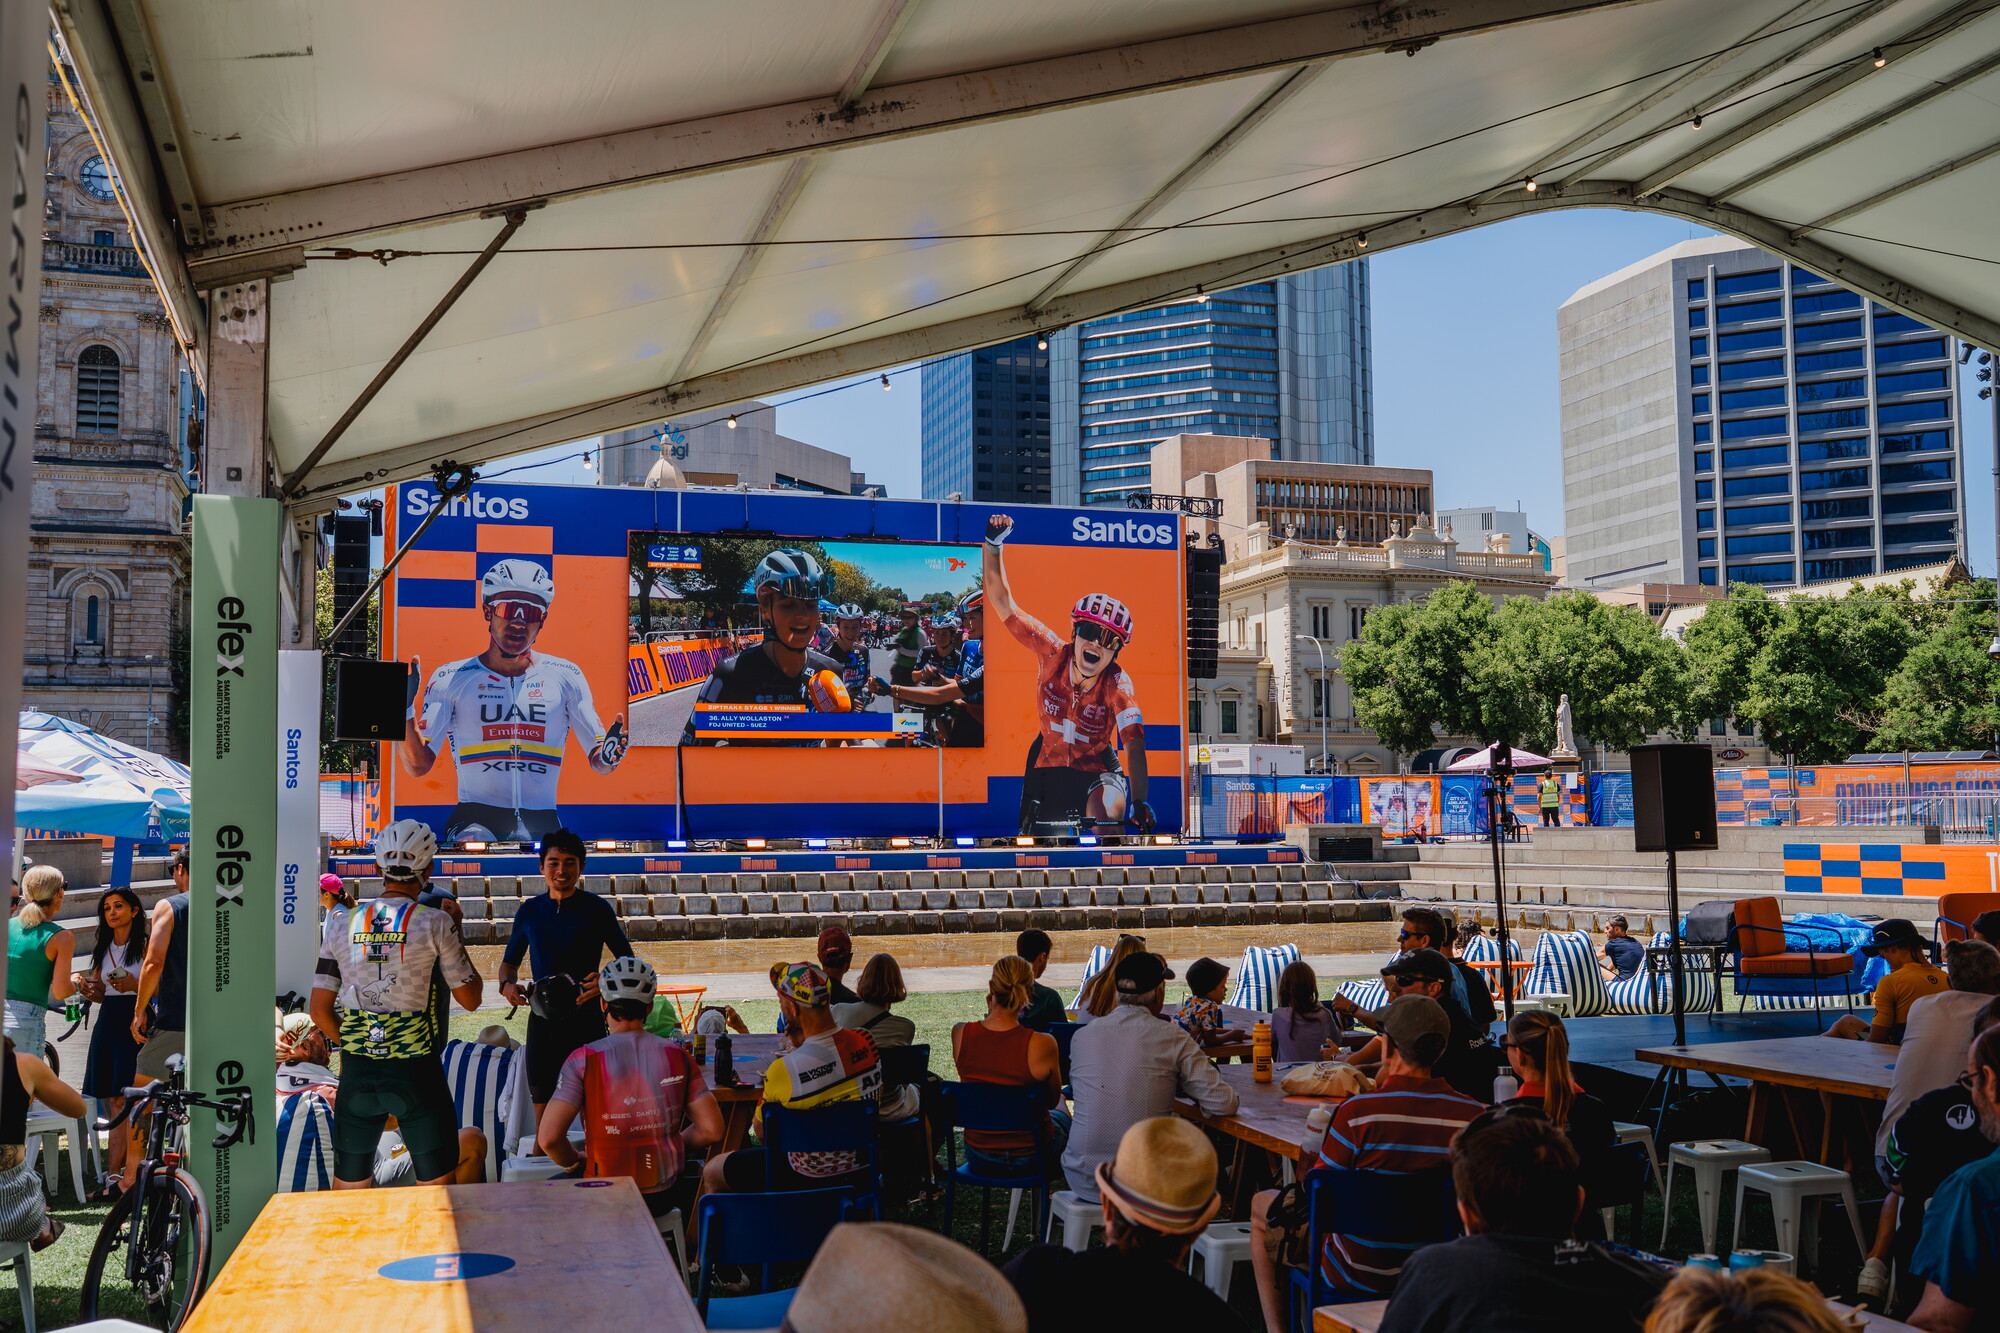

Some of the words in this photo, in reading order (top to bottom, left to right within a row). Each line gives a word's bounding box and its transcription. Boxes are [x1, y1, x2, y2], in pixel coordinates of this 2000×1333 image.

[1072, 516, 1173, 545] Santos
[216, 596, 252, 678] efex
[480, 704, 547, 723] UAE
[488, 728, 540, 738] Emirates
[286, 728, 302, 789] Santos
[482, 761, 547, 775] XRG
[1226, 780, 1256, 791] Santos
[1226, 792, 1256, 834] TOUR
[1257, 792, 1290, 834] DOWN
[216, 825, 252, 908] efex
[283, 864, 298, 925] Santos
[354, 932, 406, 943] TEKKERZ
[808, 1061, 837, 1076] VICTORY
